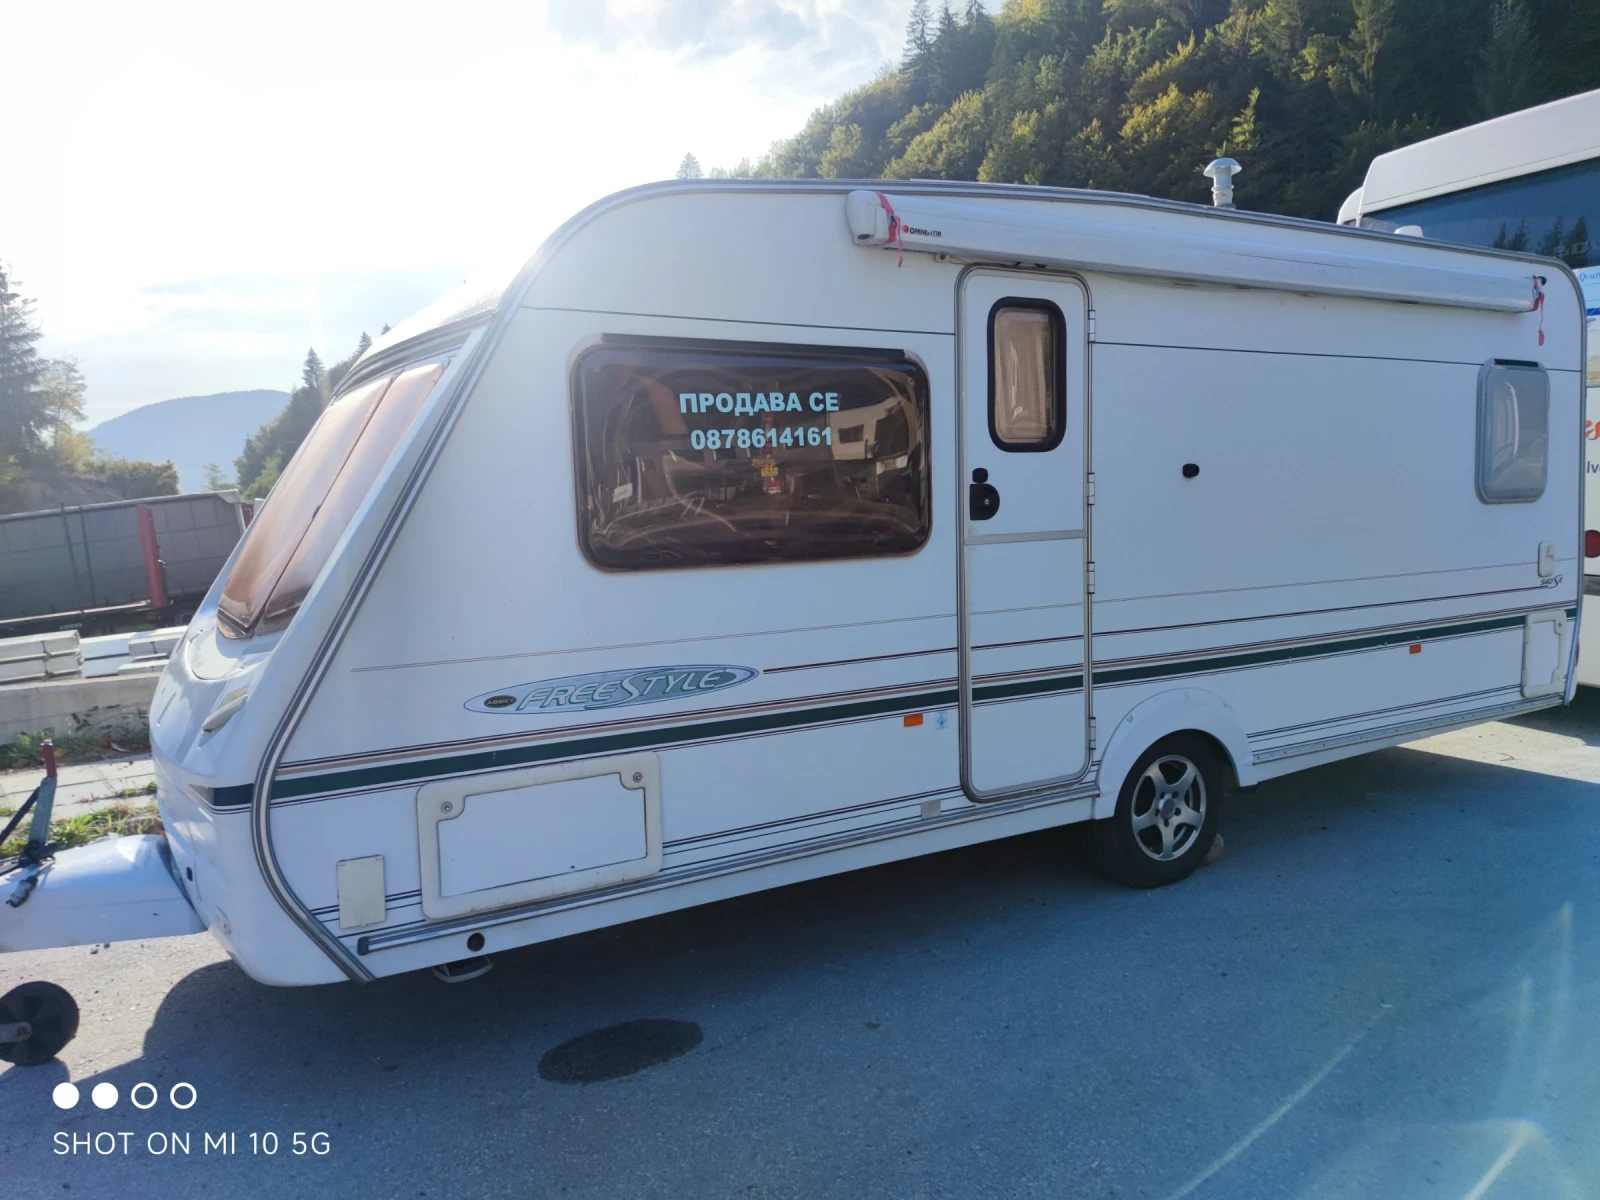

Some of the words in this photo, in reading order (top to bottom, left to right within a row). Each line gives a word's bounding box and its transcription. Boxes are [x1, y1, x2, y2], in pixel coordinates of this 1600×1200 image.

[679, 392, 802, 416] ПРОДАВА
[809, 392, 839, 412] СЕ
[690, 427, 832, 450] 0878614161
[487, 698, 515, 706] ABBEY
